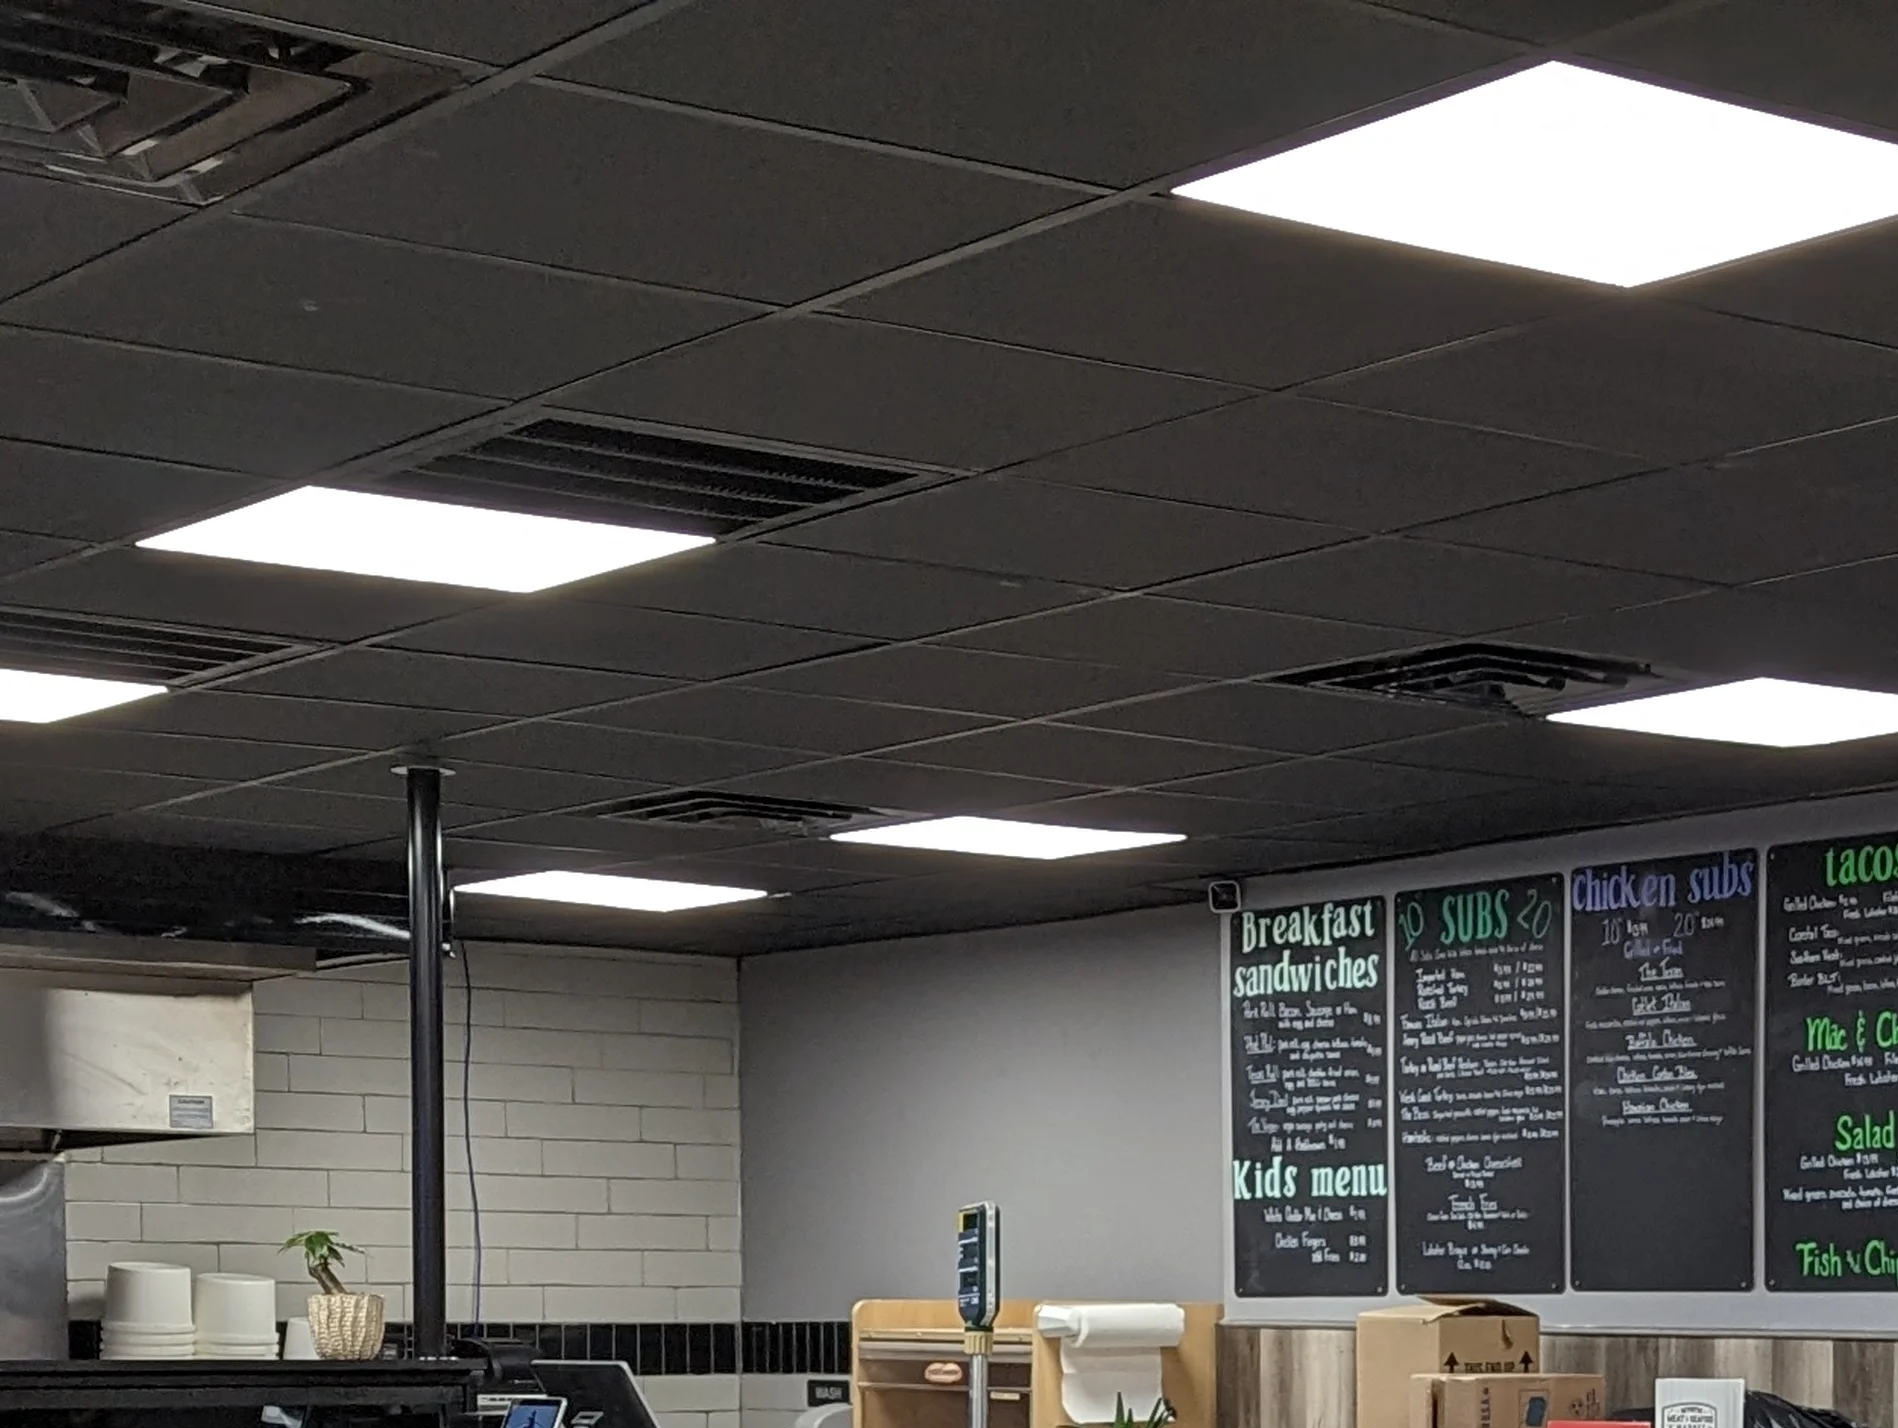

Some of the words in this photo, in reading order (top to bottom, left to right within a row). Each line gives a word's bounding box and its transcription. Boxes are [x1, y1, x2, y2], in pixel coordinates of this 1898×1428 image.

[1573, 864, 1676, 911] chicken
[1688, 852, 1754, 903] subs
[1784, 896, 1807, 912] Grilled
[1440, 889, 1510, 945] SUBS
[1243, 901, 1375, 954] Breakfast
[1623, 938, 1650, 959] Grilled
[1662, 938, 1683, 955] Fried
[1233, 946, 1379, 997] sandwiches
[1639, 962, 1656, 980] The
[1447, 982, 1468, 996] Turkey
[1439, 996, 1458, 1009] Beef
[1662, 1029, 1695, 1047] Chicken
[1806, 1016, 1848, 1052] Mac
[1792, 1055, 1820, 1072] Grilled
[1822, 1054, 1850, 1070] Chicken
[1617, 1066, 1646, 1083] Chicken
[1844, 1073, 1866, 1086] Fresh
[1869, 1070, 1898, 1085] Lobster
[1659, 1097, 1691, 1112] Chicken
[1835, 1109, 1896, 1151] Salad
[1425, 1155, 1447, 1172] Beef
[1456, 1155, 1480, 1170] Chicken
[1800, 1156, 1825, 1170] Grilled
[1827, 1154, 1855, 1166] Chicken
[1233, 1155, 1298, 1199] Kids
[1310, 1164, 1387, 1197] menu
[1843, 1170, 1862, 1180] Fresh
[1865, 1167, 1889, 1179] Lobster
[1448, 1194, 1475, 1210] French
[1479, 1193, 1497, 1210] Fries
[1275, 1232, 1298, 1248] Chicken
[1302, 1231, 1326, 1250] Fingers
[1422, 1242, 1445, 1256] Lobster
[1324, 1248, 1340, 1262] Fries
[1795, 1242, 1842, 1276] Fish
[1504, 1361, 1515, 1373] UP
